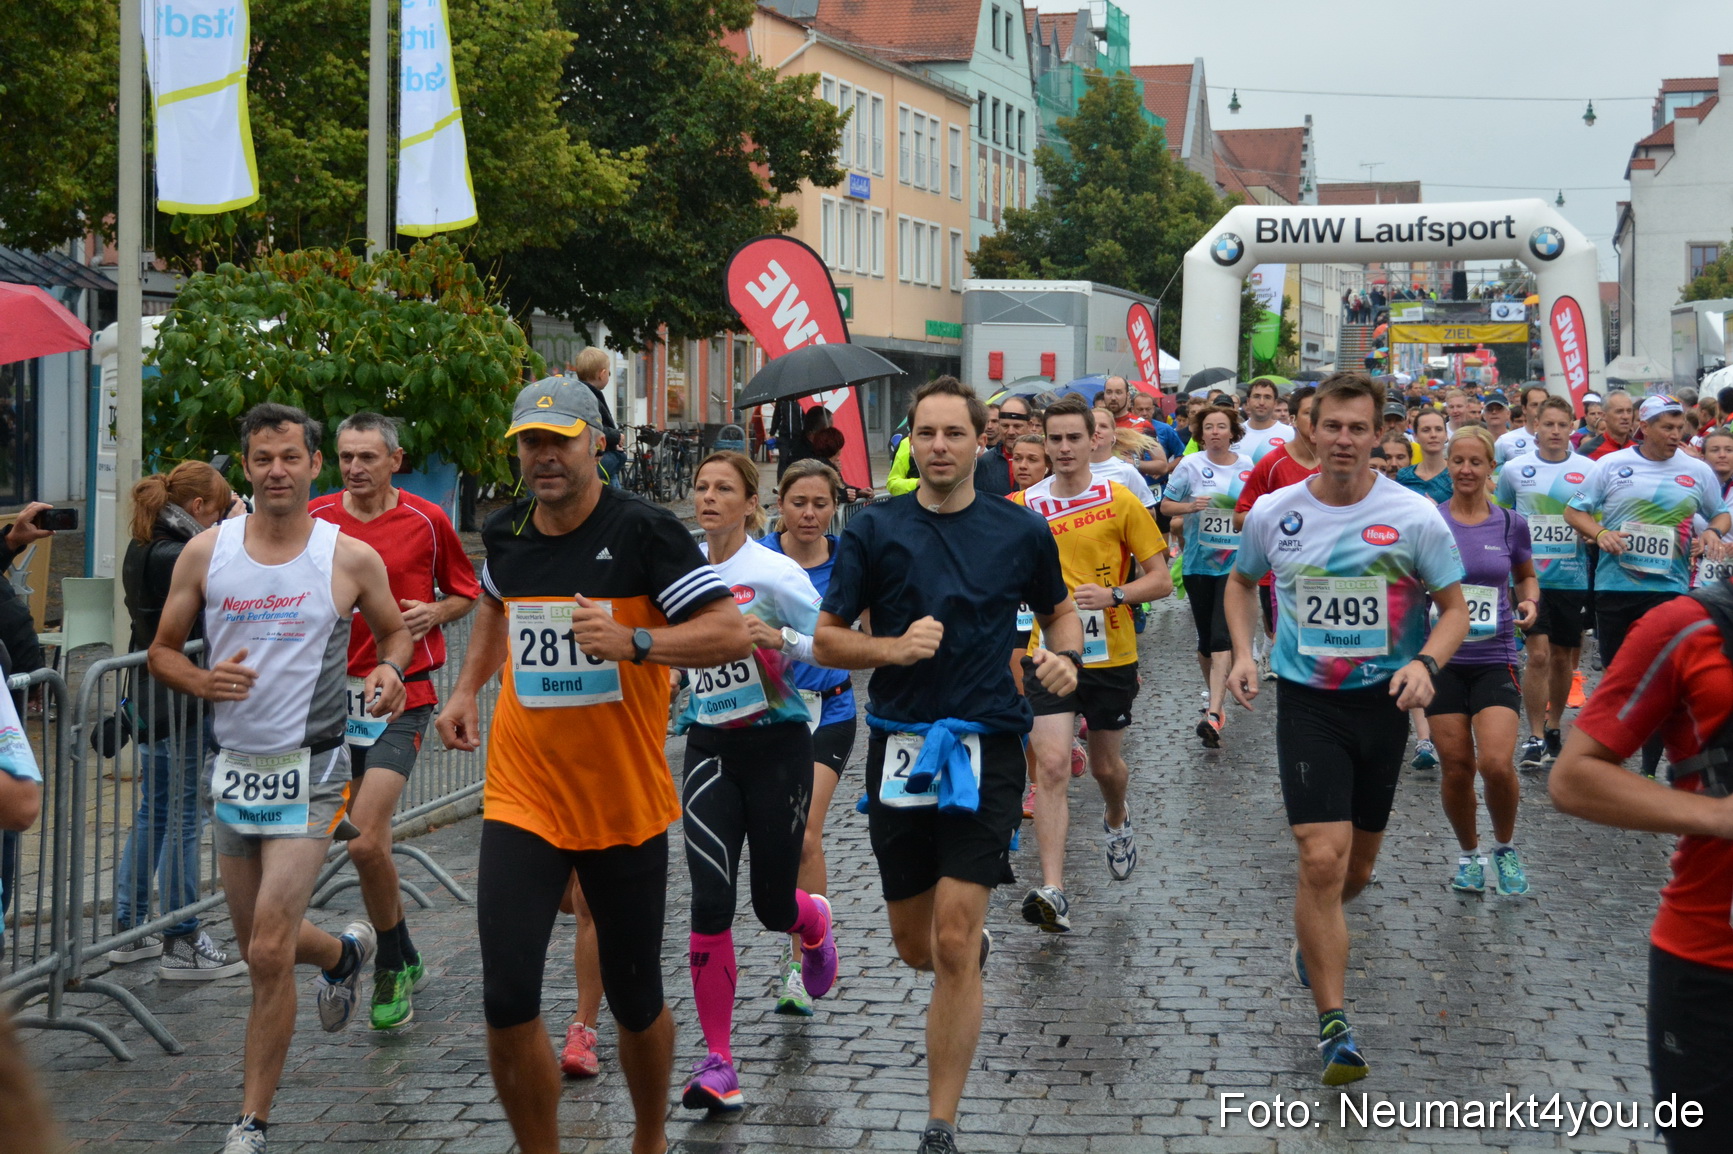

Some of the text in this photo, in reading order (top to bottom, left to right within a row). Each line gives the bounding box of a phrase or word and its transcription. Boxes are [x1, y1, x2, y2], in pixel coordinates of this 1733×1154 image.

[1256, 215, 1516, 247] BMW Laufsport
[1443, 328, 1474, 339] ZIEL
[1073, 508, 1117, 529] BÖGL
[1203, 517, 1241, 534] 231
[1210, 536, 1231, 544] Andrea
[1367, 529, 1395, 540] Hervis
[1533, 526, 1573, 542] 2452
[1626, 534, 1669, 556] 3086
[1335, 580, 1378, 590] BOCK
[226, 611, 299, 622] Pure Performance
[1307, 596, 1379, 626] 2493
[1324, 633, 1361, 646] Arnold
[542, 677, 583, 692] Bernd
[695, 662, 750, 695] 2635
[707, 697, 738, 713] Conny
[255, 752, 303, 769] BOCK
[222, 768, 301, 801] 2899
[239, 808, 283, 823] Markus
